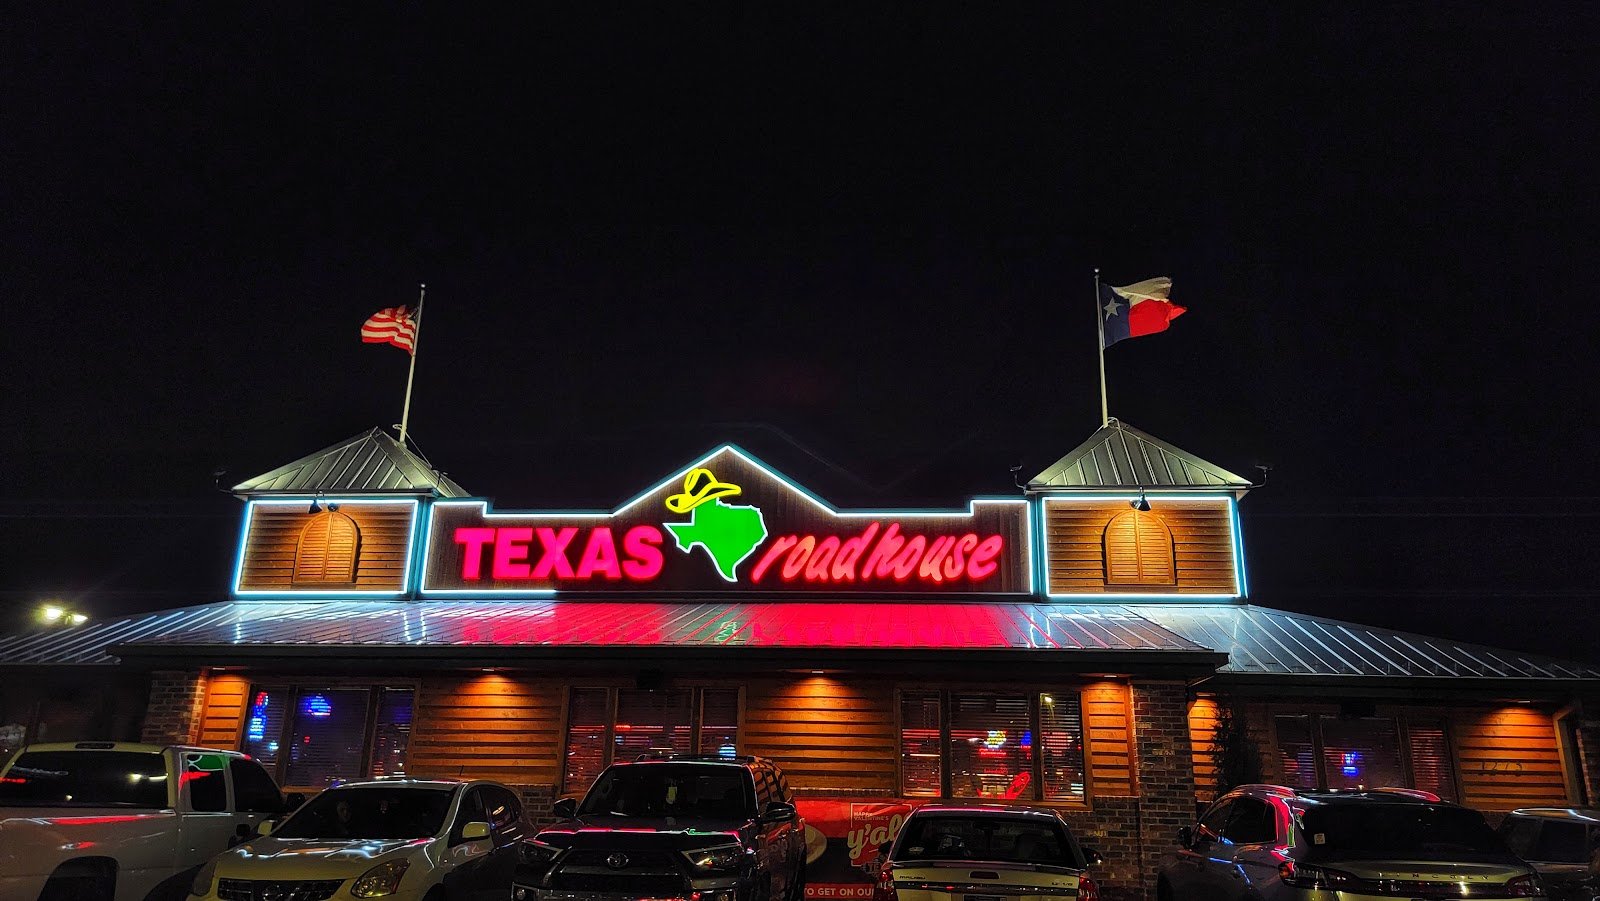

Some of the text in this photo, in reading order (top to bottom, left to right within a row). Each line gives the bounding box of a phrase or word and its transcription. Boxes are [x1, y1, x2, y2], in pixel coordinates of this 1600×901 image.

[454, 521, 1003, 583] TEXAS roadhouse
[817, 887, 836, 896] GET
[839, 887, 854, 896] ON
